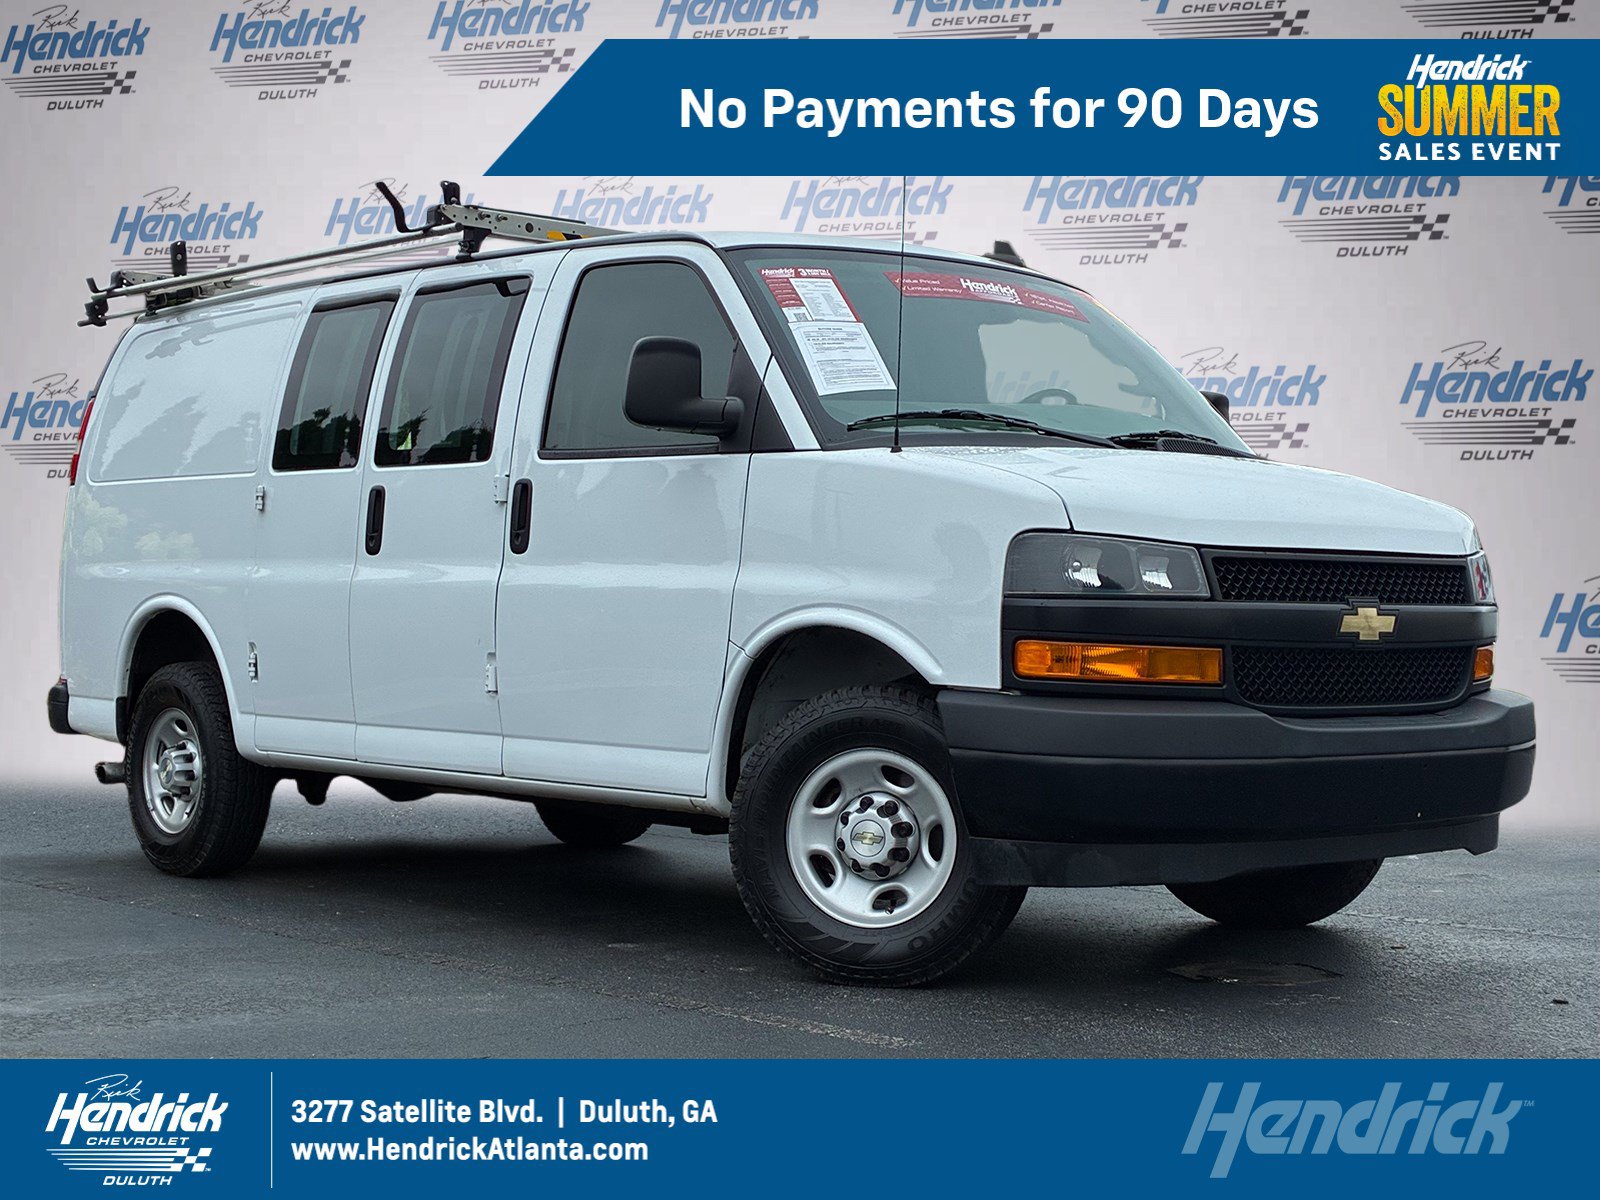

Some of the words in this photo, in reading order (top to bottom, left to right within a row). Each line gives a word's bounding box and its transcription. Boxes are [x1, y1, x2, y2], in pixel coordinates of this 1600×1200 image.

[1182, 0, 1287, 14] CHEVROLET
[427, 0, 591, 52] Hendrick
[931, 13, 1032, 27] CHEVROLET
[209, 6, 366, 63] Hendrick
[692, 26, 788, 39] CHEVROLET
[1461, 28, 1534, 39] DULUTH
[0, 18, 150, 74] Hendrick
[463, 38, 555, 51] CHEVROLET
[244, 50, 332, 63] CHEVROLET
[33, 61, 117, 74] CHEVROLET
[478, 77, 540, 90] DULUTH
[258, 88, 317, 101] DULUTH
[47, 99, 104, 111] DULUTH
[551, 184, 714, 228] Hendrick
[780, 176, 954, 232] Hendrick
[1319, 203, 1426, 216] CHEVROLET
[1063, 212, 1165, 225] CHEVROLET
[110, 201, 264, 256] Hendrick
[144, 245, 230, 256] CHEROLET
[1336, 245, 1408, 258] DULUTH
[1079, 253, 1148, 265] DULUTH
[960, 278, 1017, 297] Hendrick
[1176, 364, 1328, 407] ndrick
[1399, 359, 1594, 418] Hendrick
[1442, 407, 1552, 418] CHEVROLET
[1460, 450, 1534, 461] DULUTH
